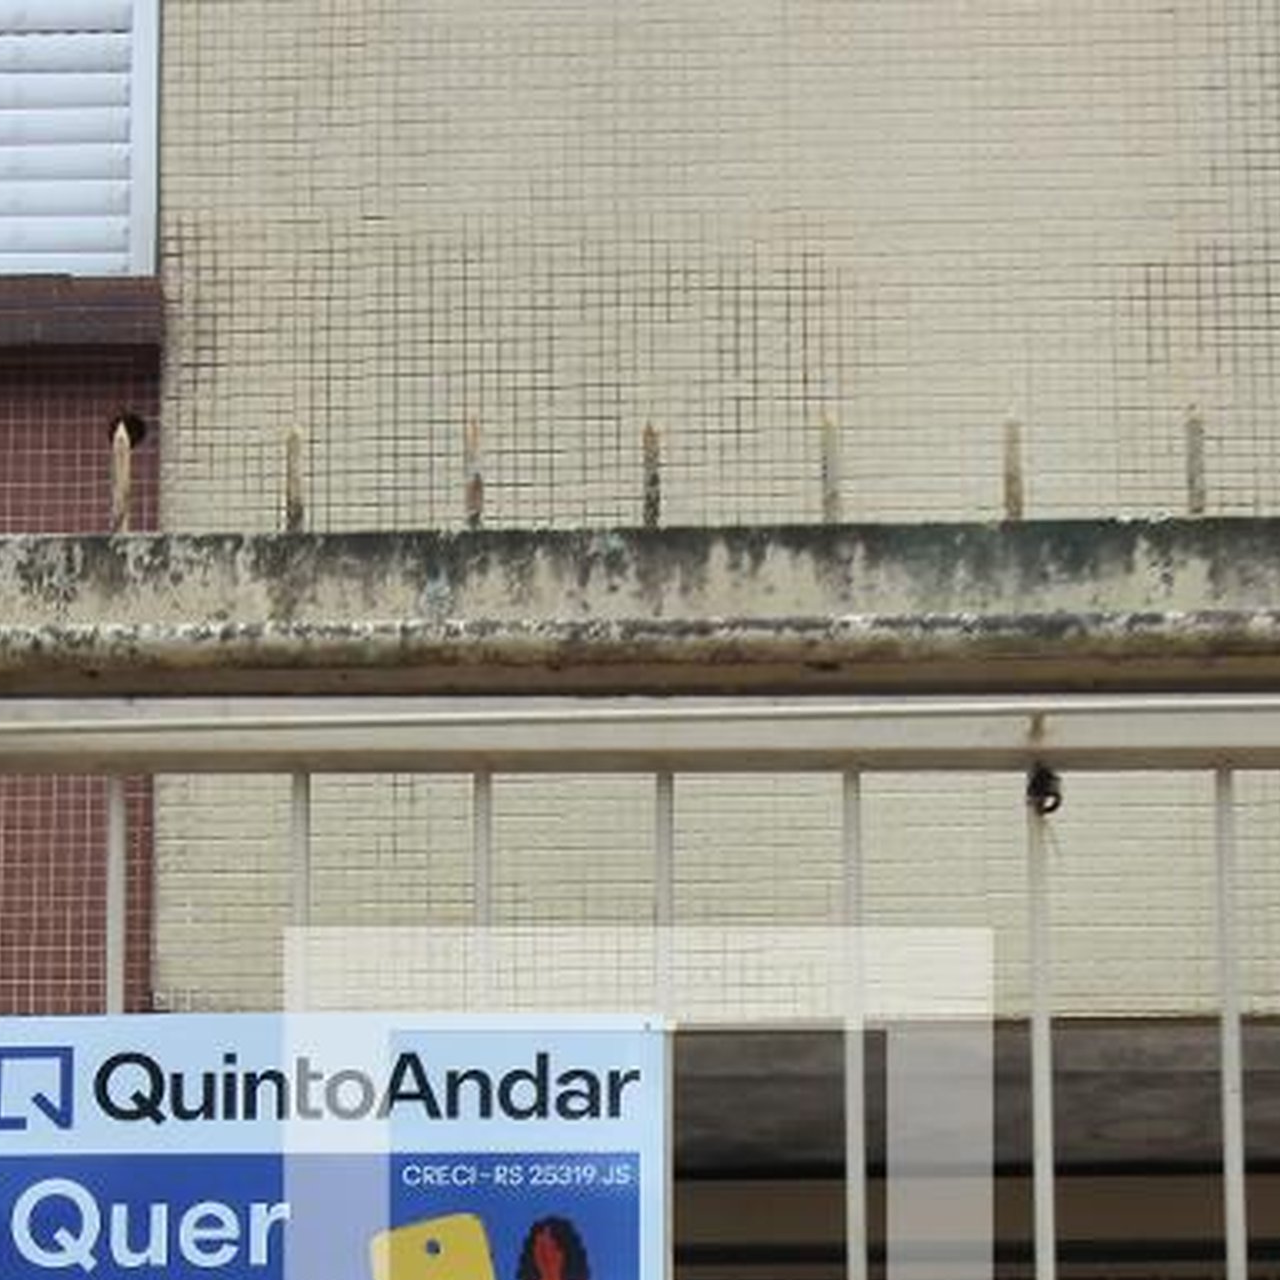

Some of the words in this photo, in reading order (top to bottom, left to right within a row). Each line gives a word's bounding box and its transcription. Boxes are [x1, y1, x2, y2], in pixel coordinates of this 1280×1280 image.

[93, 1051, 641, 1125] QuintoAndar
[529, 1164, 596, 1187] 25319
[10, 1178, 292, 1273] Quer
